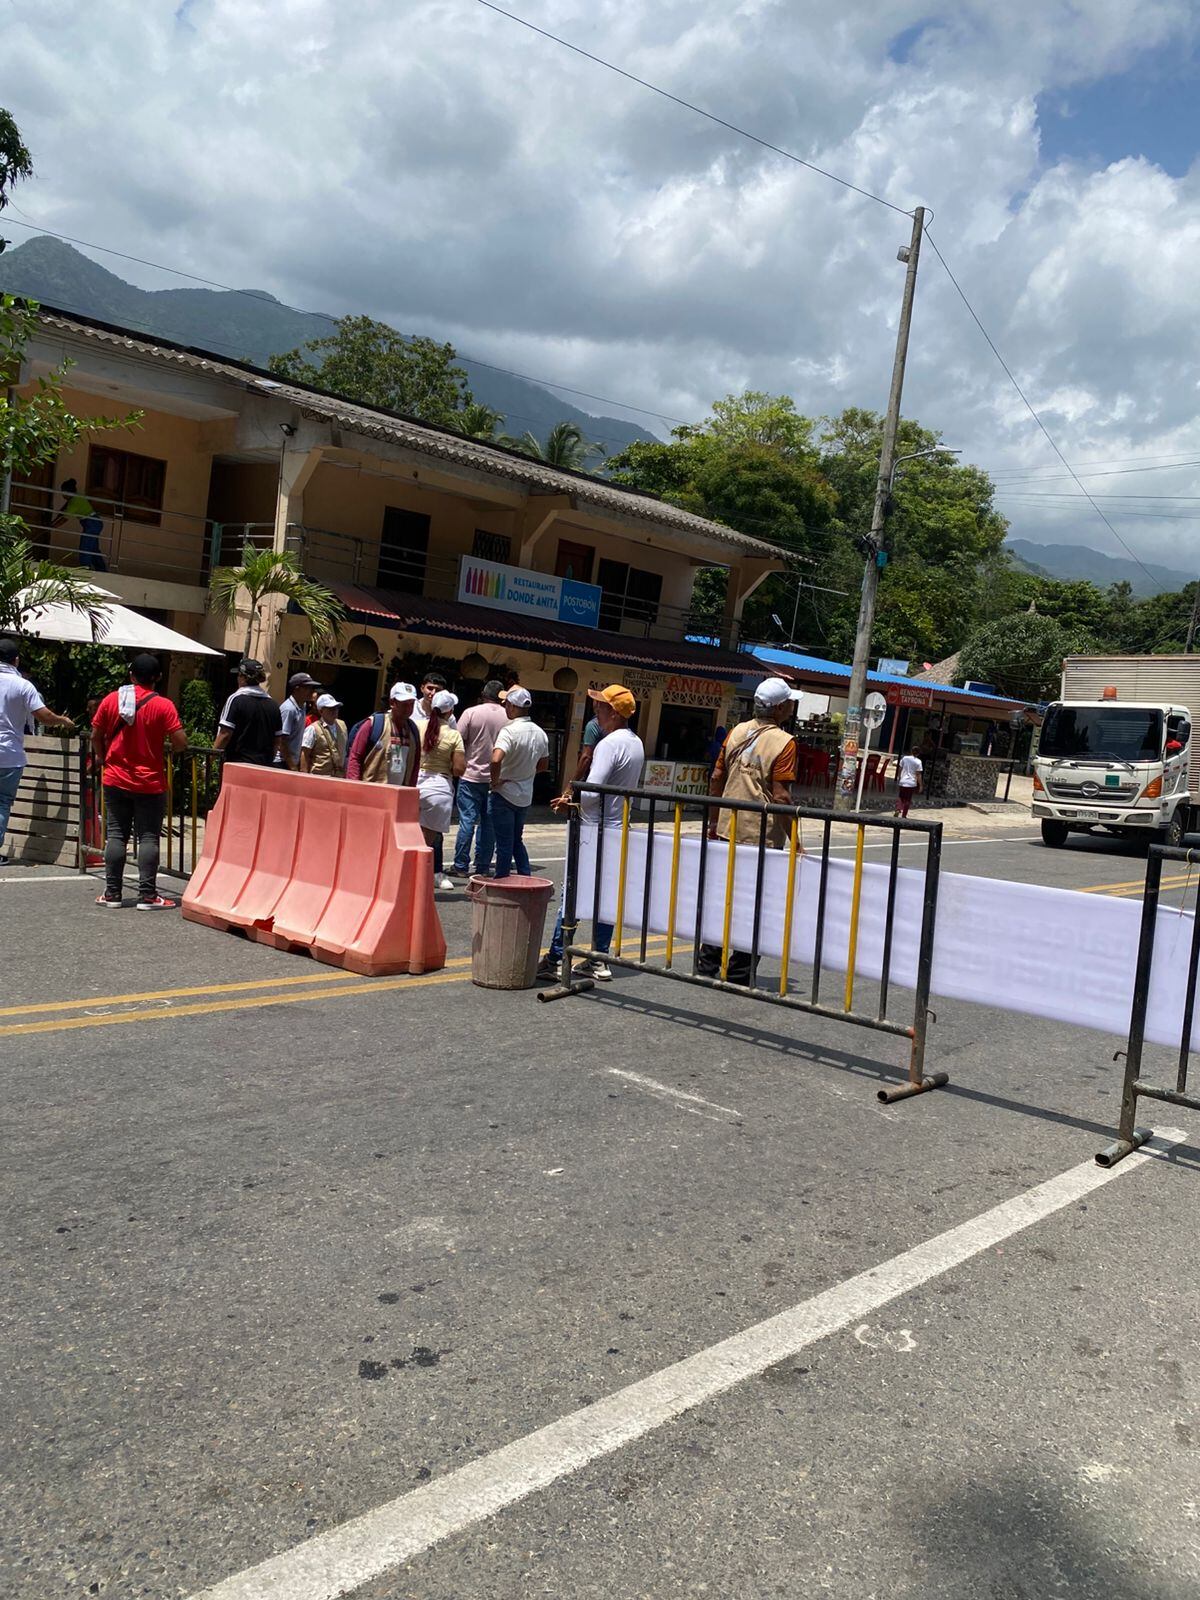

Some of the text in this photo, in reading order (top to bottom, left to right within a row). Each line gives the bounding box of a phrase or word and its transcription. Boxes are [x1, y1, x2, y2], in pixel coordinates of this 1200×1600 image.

[513, 577, 556, 593] RESTAURANTE
[507, 589, 558, 610] DONDE ANITA
[666, 676, 723, 696] ANITA
